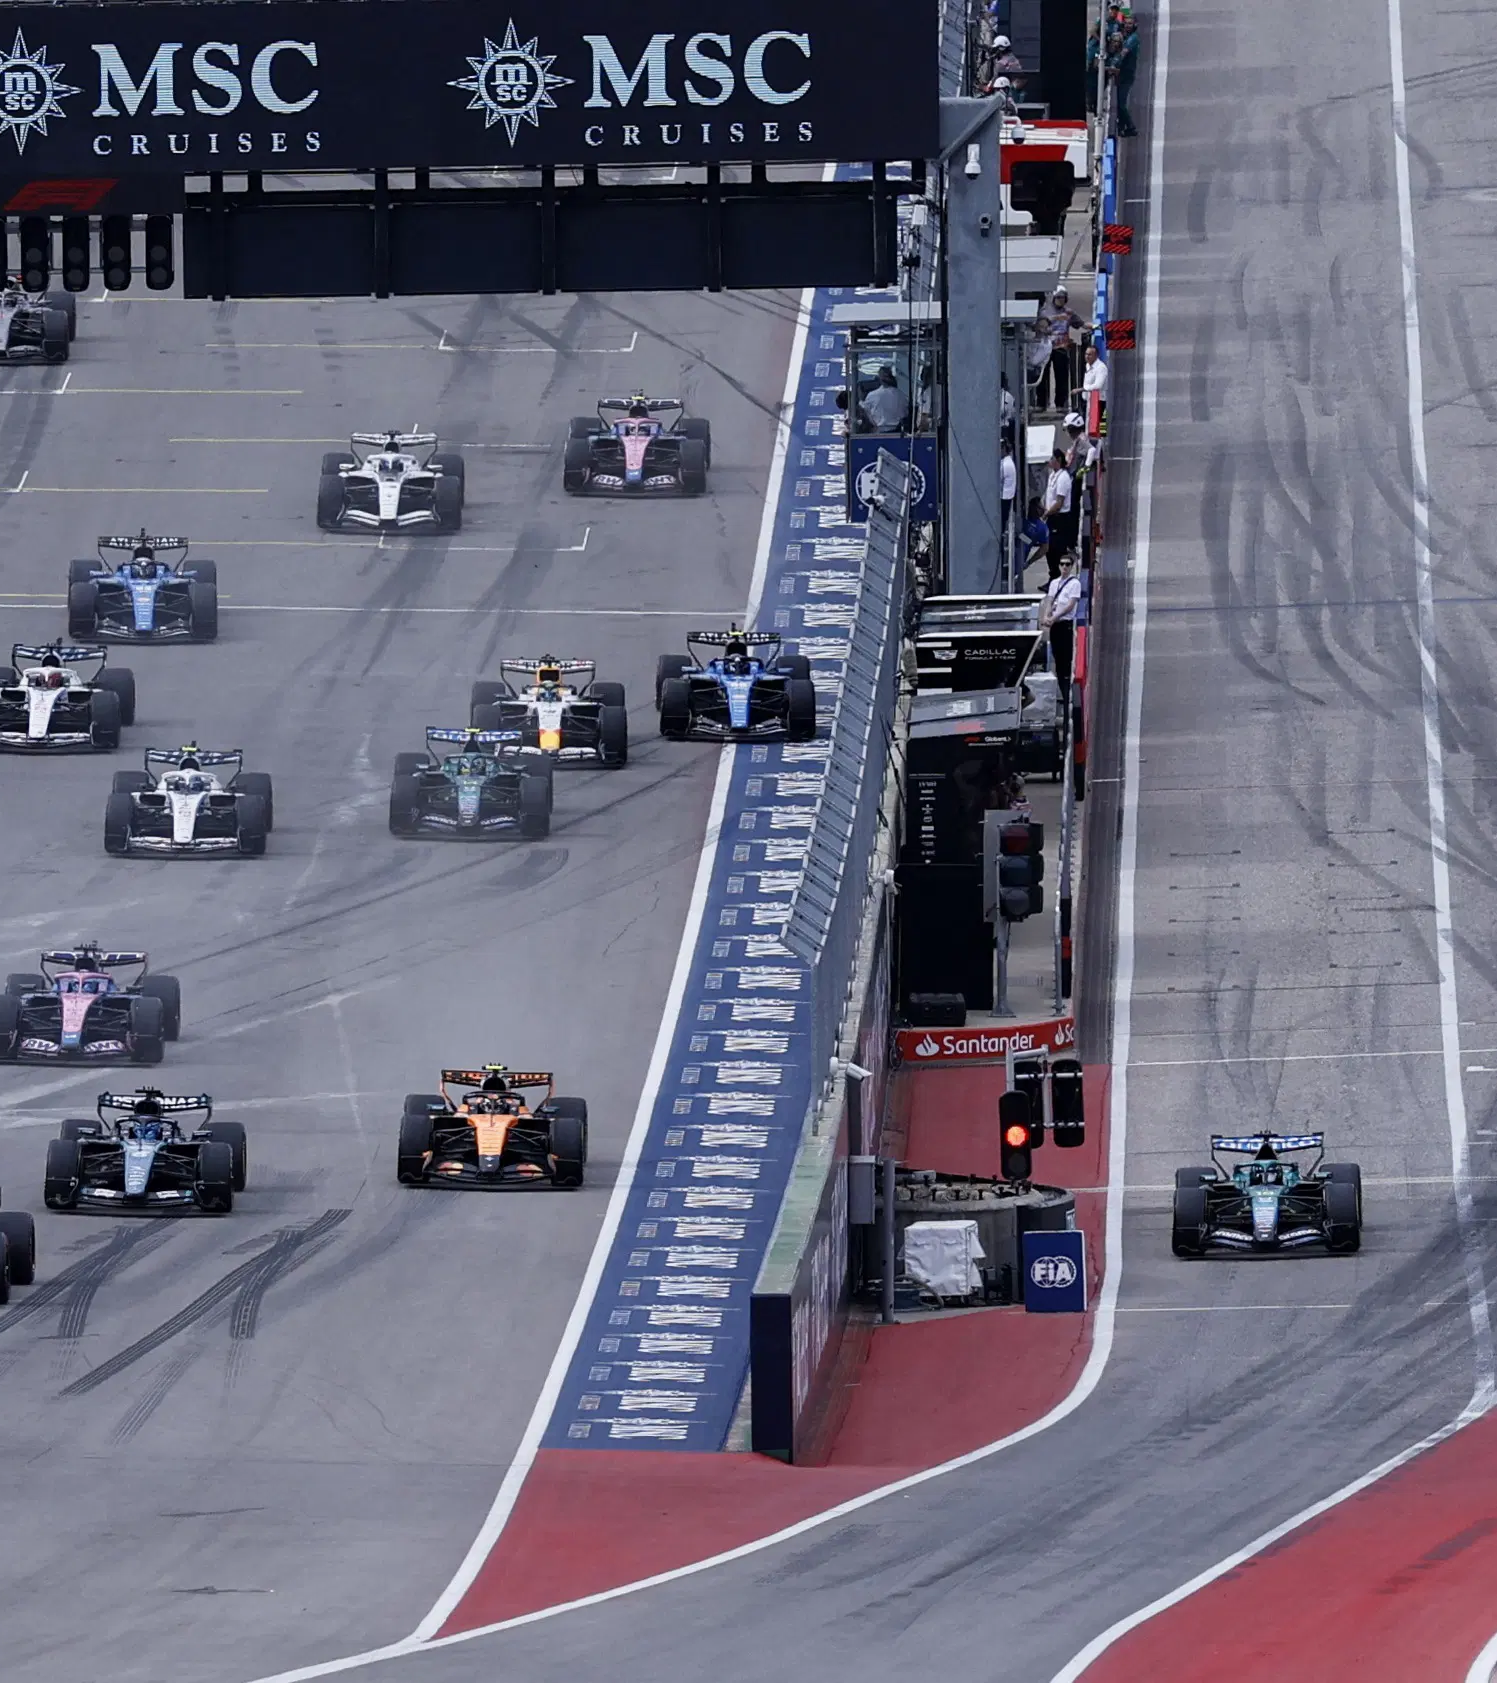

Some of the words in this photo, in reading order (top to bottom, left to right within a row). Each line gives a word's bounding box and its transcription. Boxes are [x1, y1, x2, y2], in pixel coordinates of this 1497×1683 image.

[91, 42, 318, 118] MSC
[583, 32, 811, 108] MSC
[93, 133, 320, 155] CRUISES
[585, 123, 812, 147] CRUISES
[964, 648, 1016, 656] CADILLAC
[943, 1032, 1034, 1055] Santander
